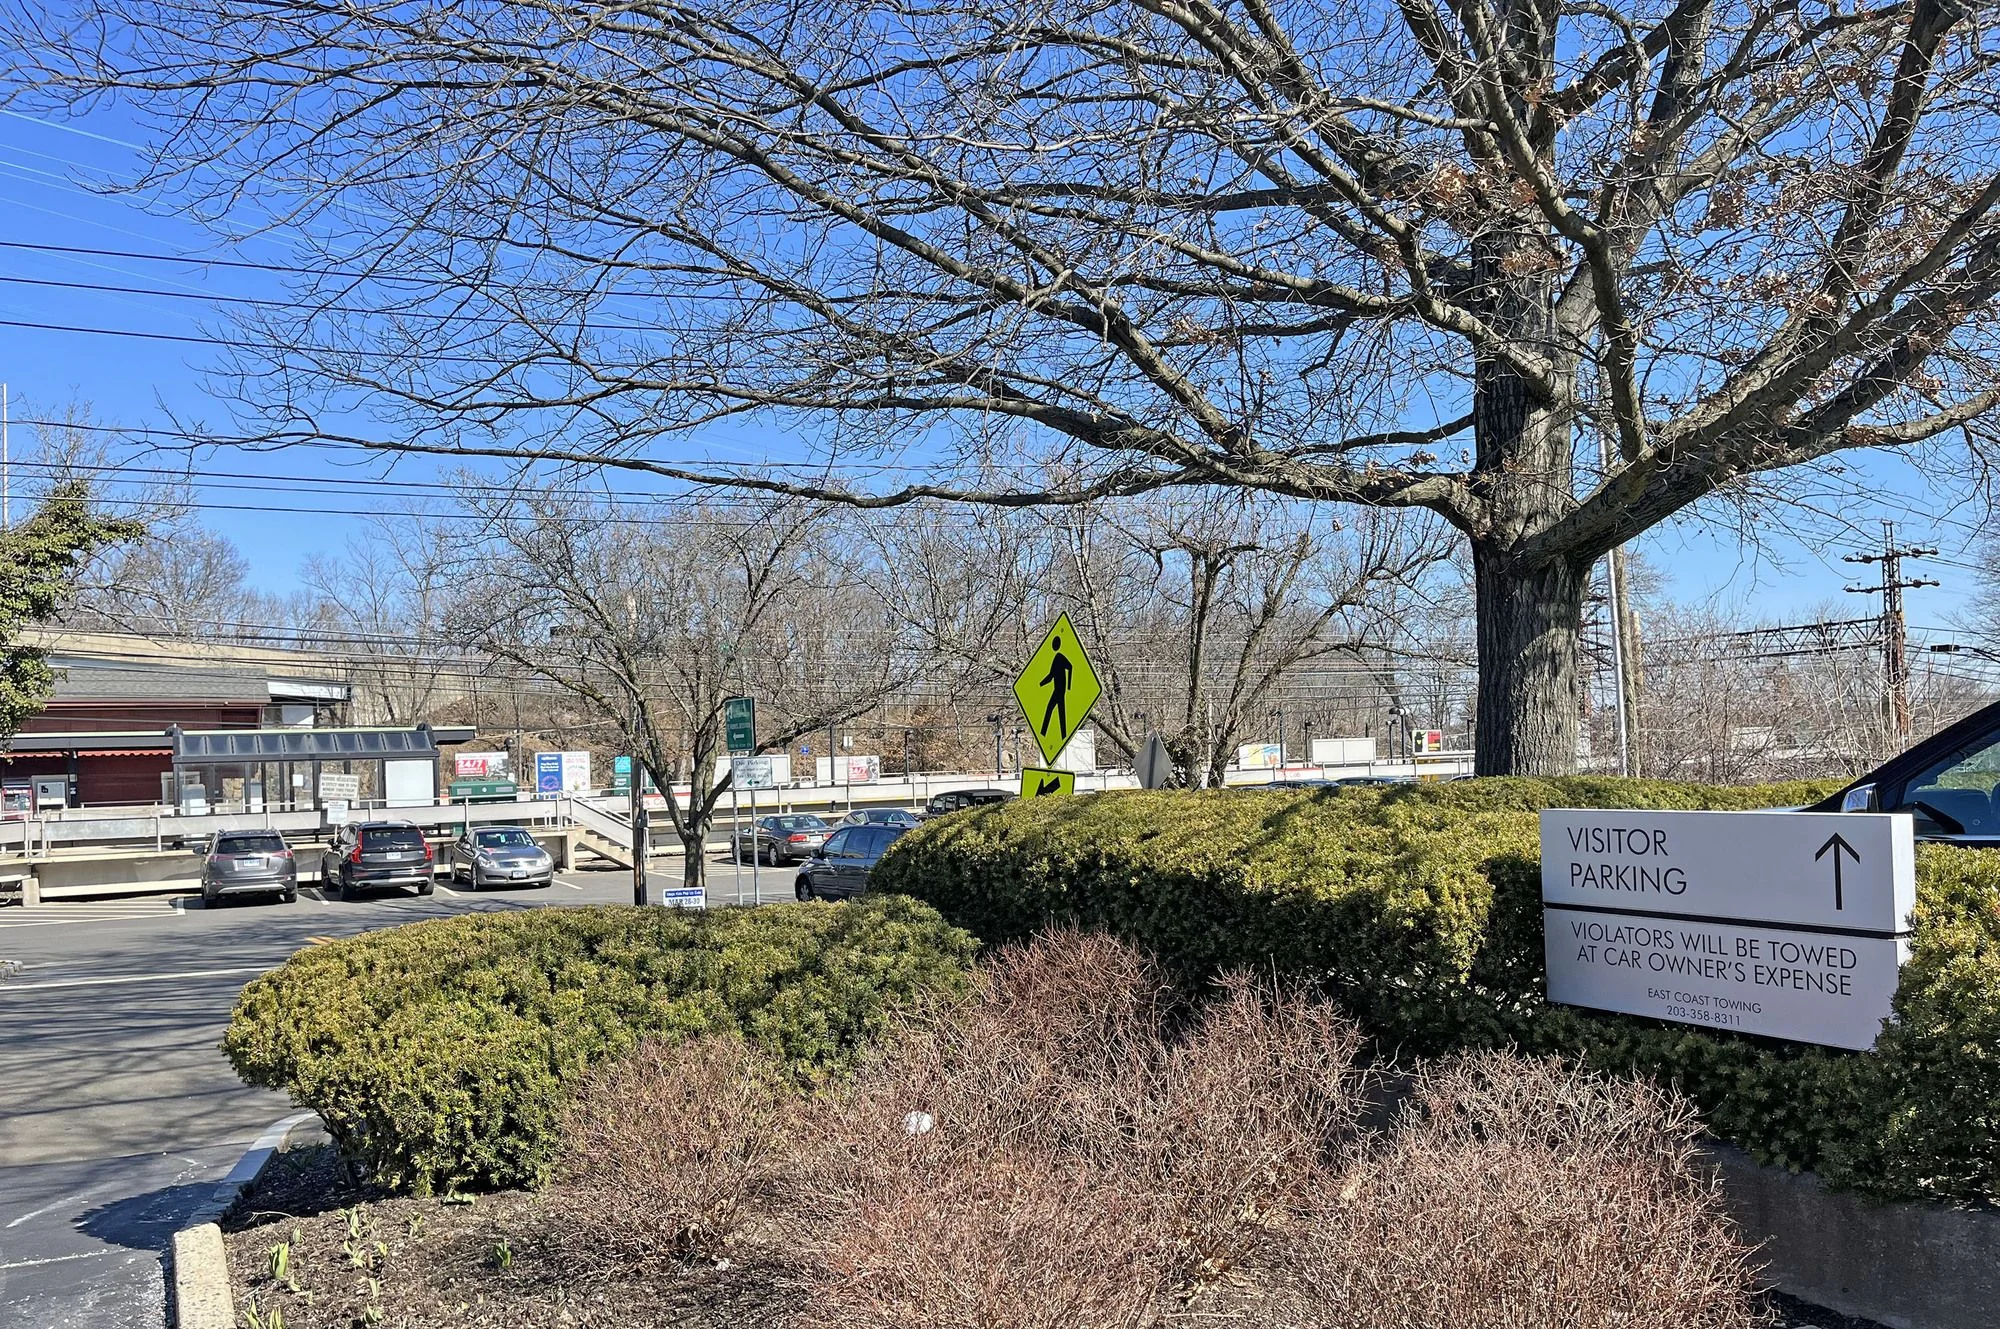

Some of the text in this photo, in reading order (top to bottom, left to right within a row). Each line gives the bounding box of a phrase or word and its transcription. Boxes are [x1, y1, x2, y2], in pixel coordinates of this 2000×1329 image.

[1567, 826, 1669, 856] VISITOR
[1570, 863, 1687, 895] PARKING
[1571, 921, 1857, 970] VIOLATORS WILL BE TOWED
[1577, 945, 1852, 996] AT CAR OWNER'S EXPENSE
[1648, 988, 1762, 1014] EAST COAST TOWING
[1667, 1005, 1741, 1026] 203-358-8311
